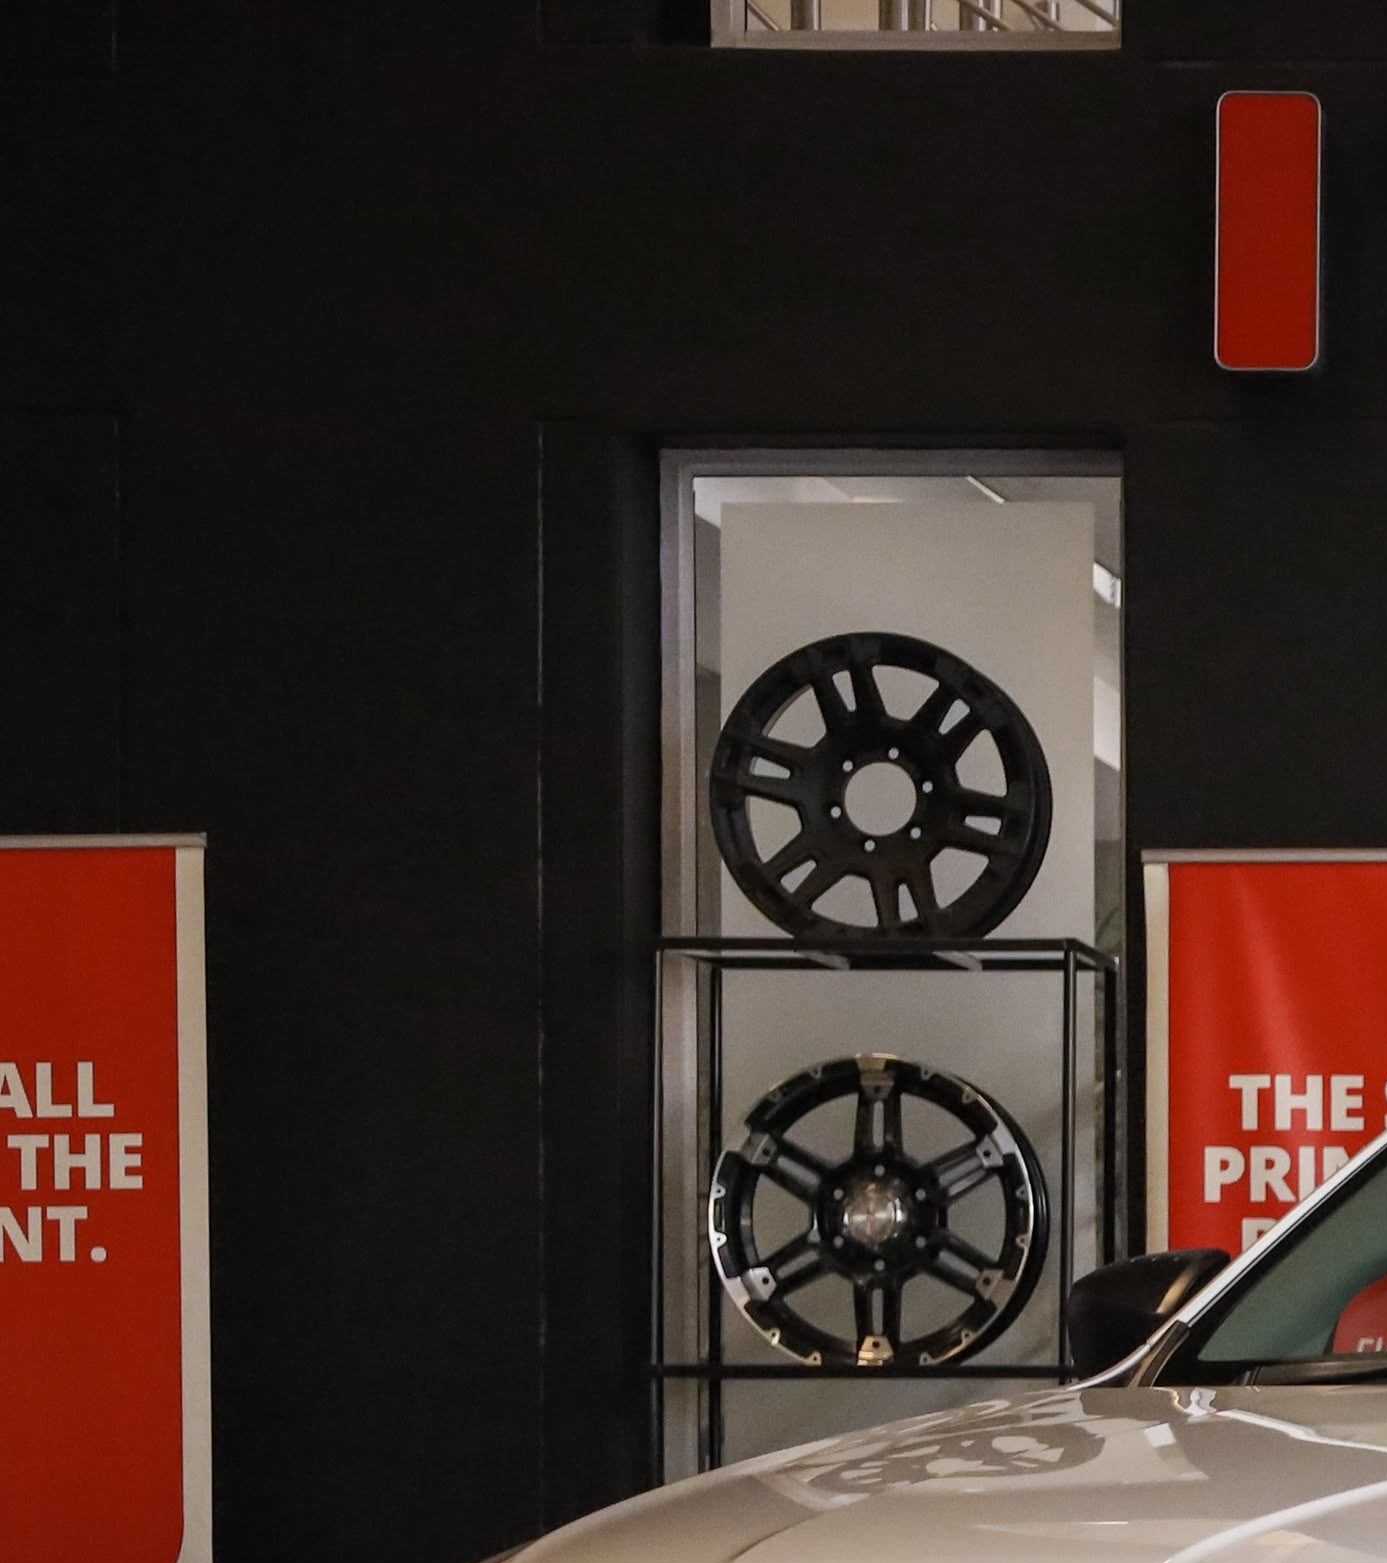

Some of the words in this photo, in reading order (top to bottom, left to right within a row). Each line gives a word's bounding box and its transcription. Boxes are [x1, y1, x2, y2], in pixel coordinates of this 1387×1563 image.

[1228, 1074, 1365, 1131] THE
[7, 1133, 143, 1190] THE
[1203, 1146, 1351, 1203] PRI
